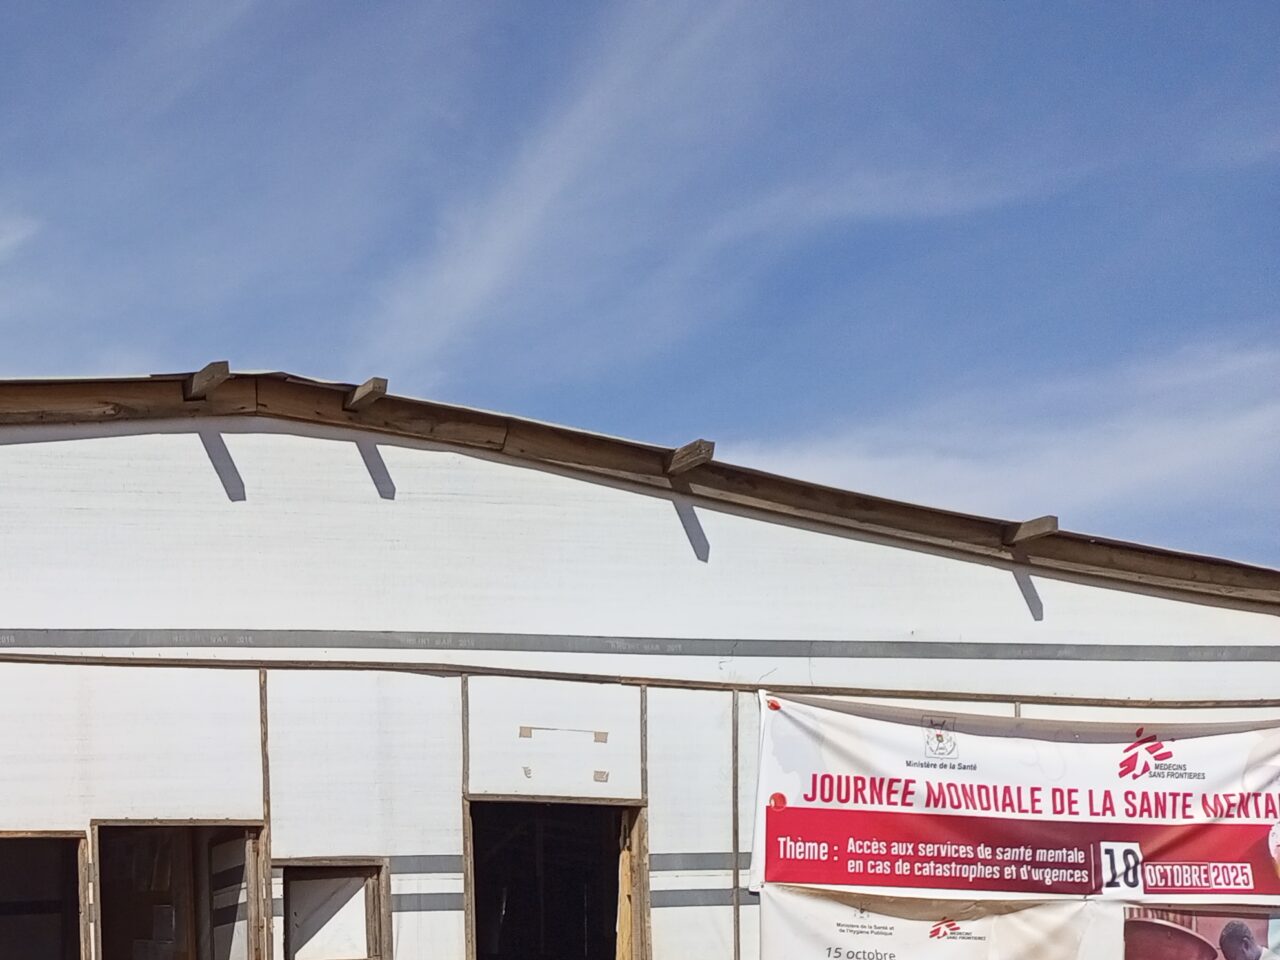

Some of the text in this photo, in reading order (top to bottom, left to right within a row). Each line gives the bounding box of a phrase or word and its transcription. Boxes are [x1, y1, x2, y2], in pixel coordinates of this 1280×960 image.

[905, 760, 937, 769] Ministère
[949, 762, 956, 770] la
[957, 762, 977, 771] Santé
[1154, 763, 1187, 771] MEDECINS
[1166, 772, 1206, 780] FRONTIERES
[803, 773, 916, 807] JOURNEE
[924, 780, 1042, 814] MONDIALE
[1051, 787, 1079, 816] DE
[1088, 789, 1116, 817] LA
[1124, 791, 1193, 819] SANTE
[777, 836, 828, 860] Thème
[847, 837, 1085, 863] Accès aux services de santé mentale
[847, 859, 1089, 885] en cas de catastrophes et d'urgences
[1145, 864, 1250, 886] OCTOBRE 2025
[825, 947, 842, 959] 15
